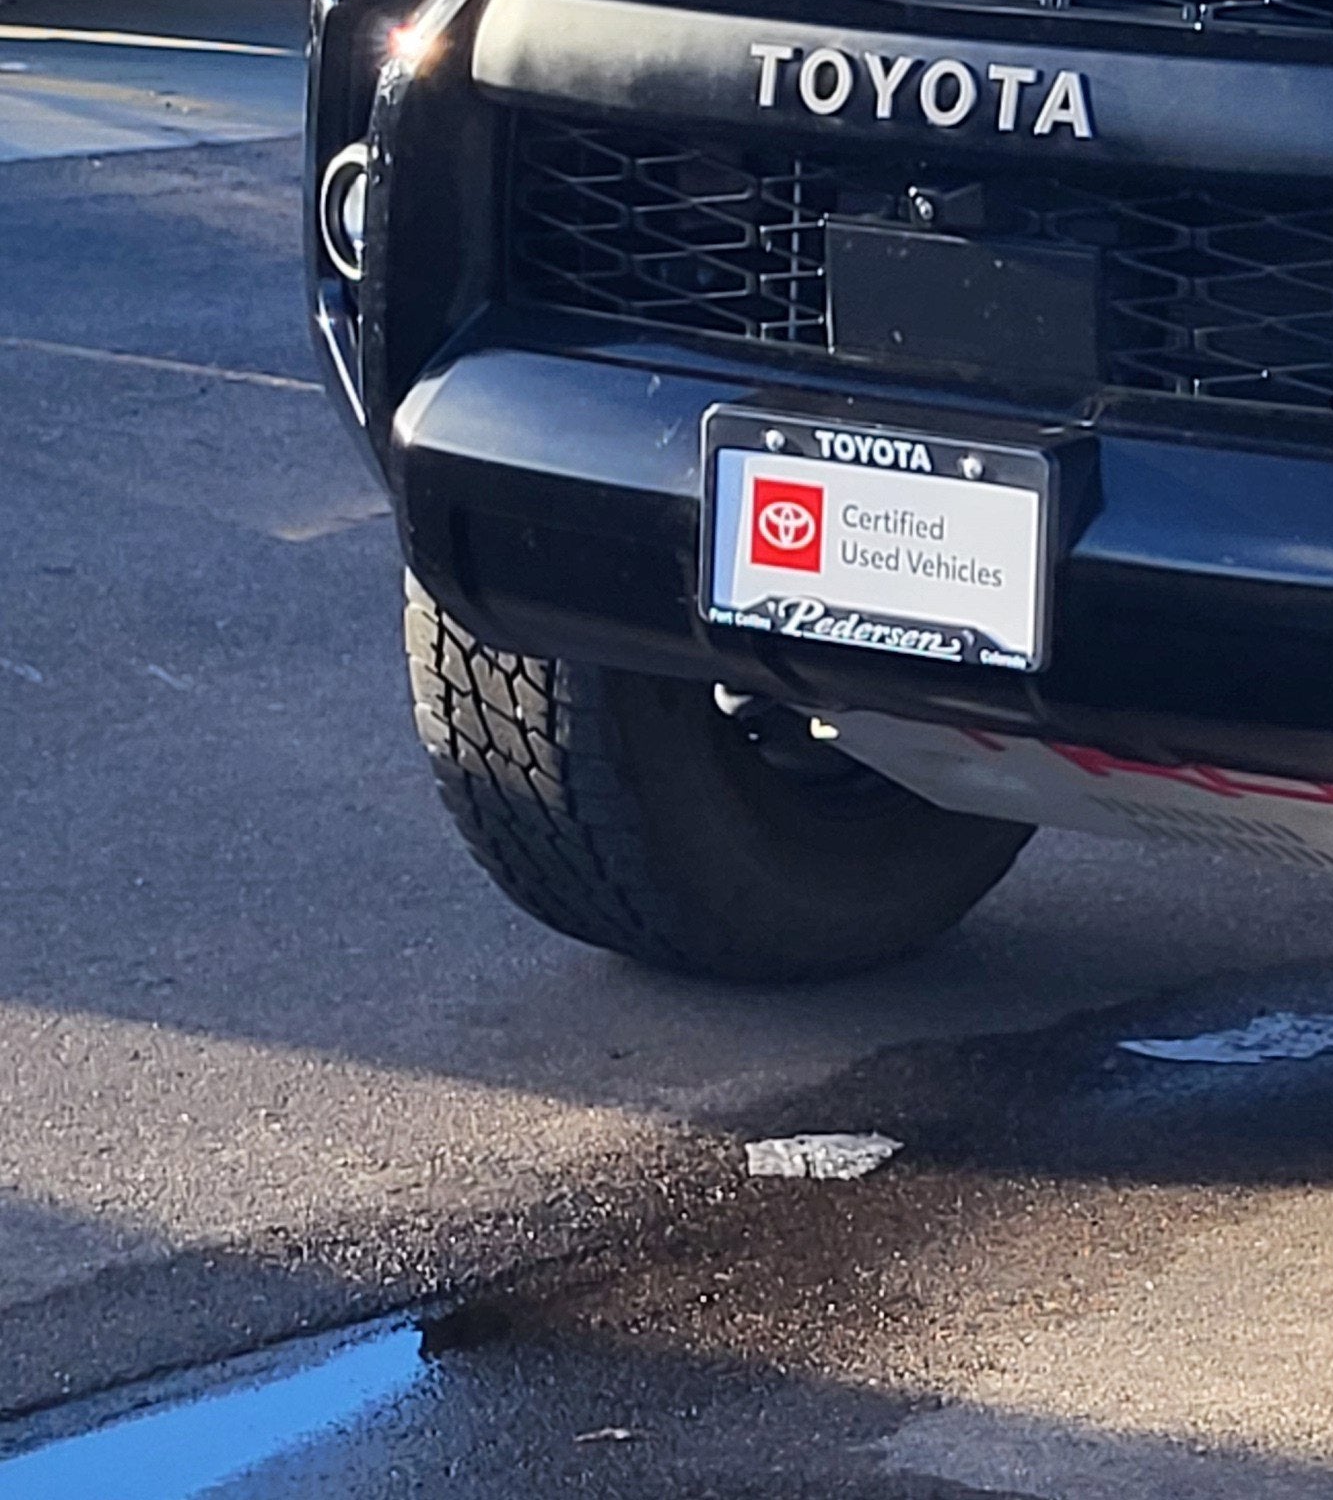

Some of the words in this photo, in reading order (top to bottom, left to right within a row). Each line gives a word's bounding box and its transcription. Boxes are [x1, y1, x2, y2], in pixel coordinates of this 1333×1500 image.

[750, 42, 1093, 139] TOYOTA
[814, 429, 932, 473] TOYOTA
[842, 503, 945, 541] Certified
[841, 539, 900, 572] Used
[907, 549, 1003, 588] Vehicles
[777, 597, 962, 658] Pedersen
